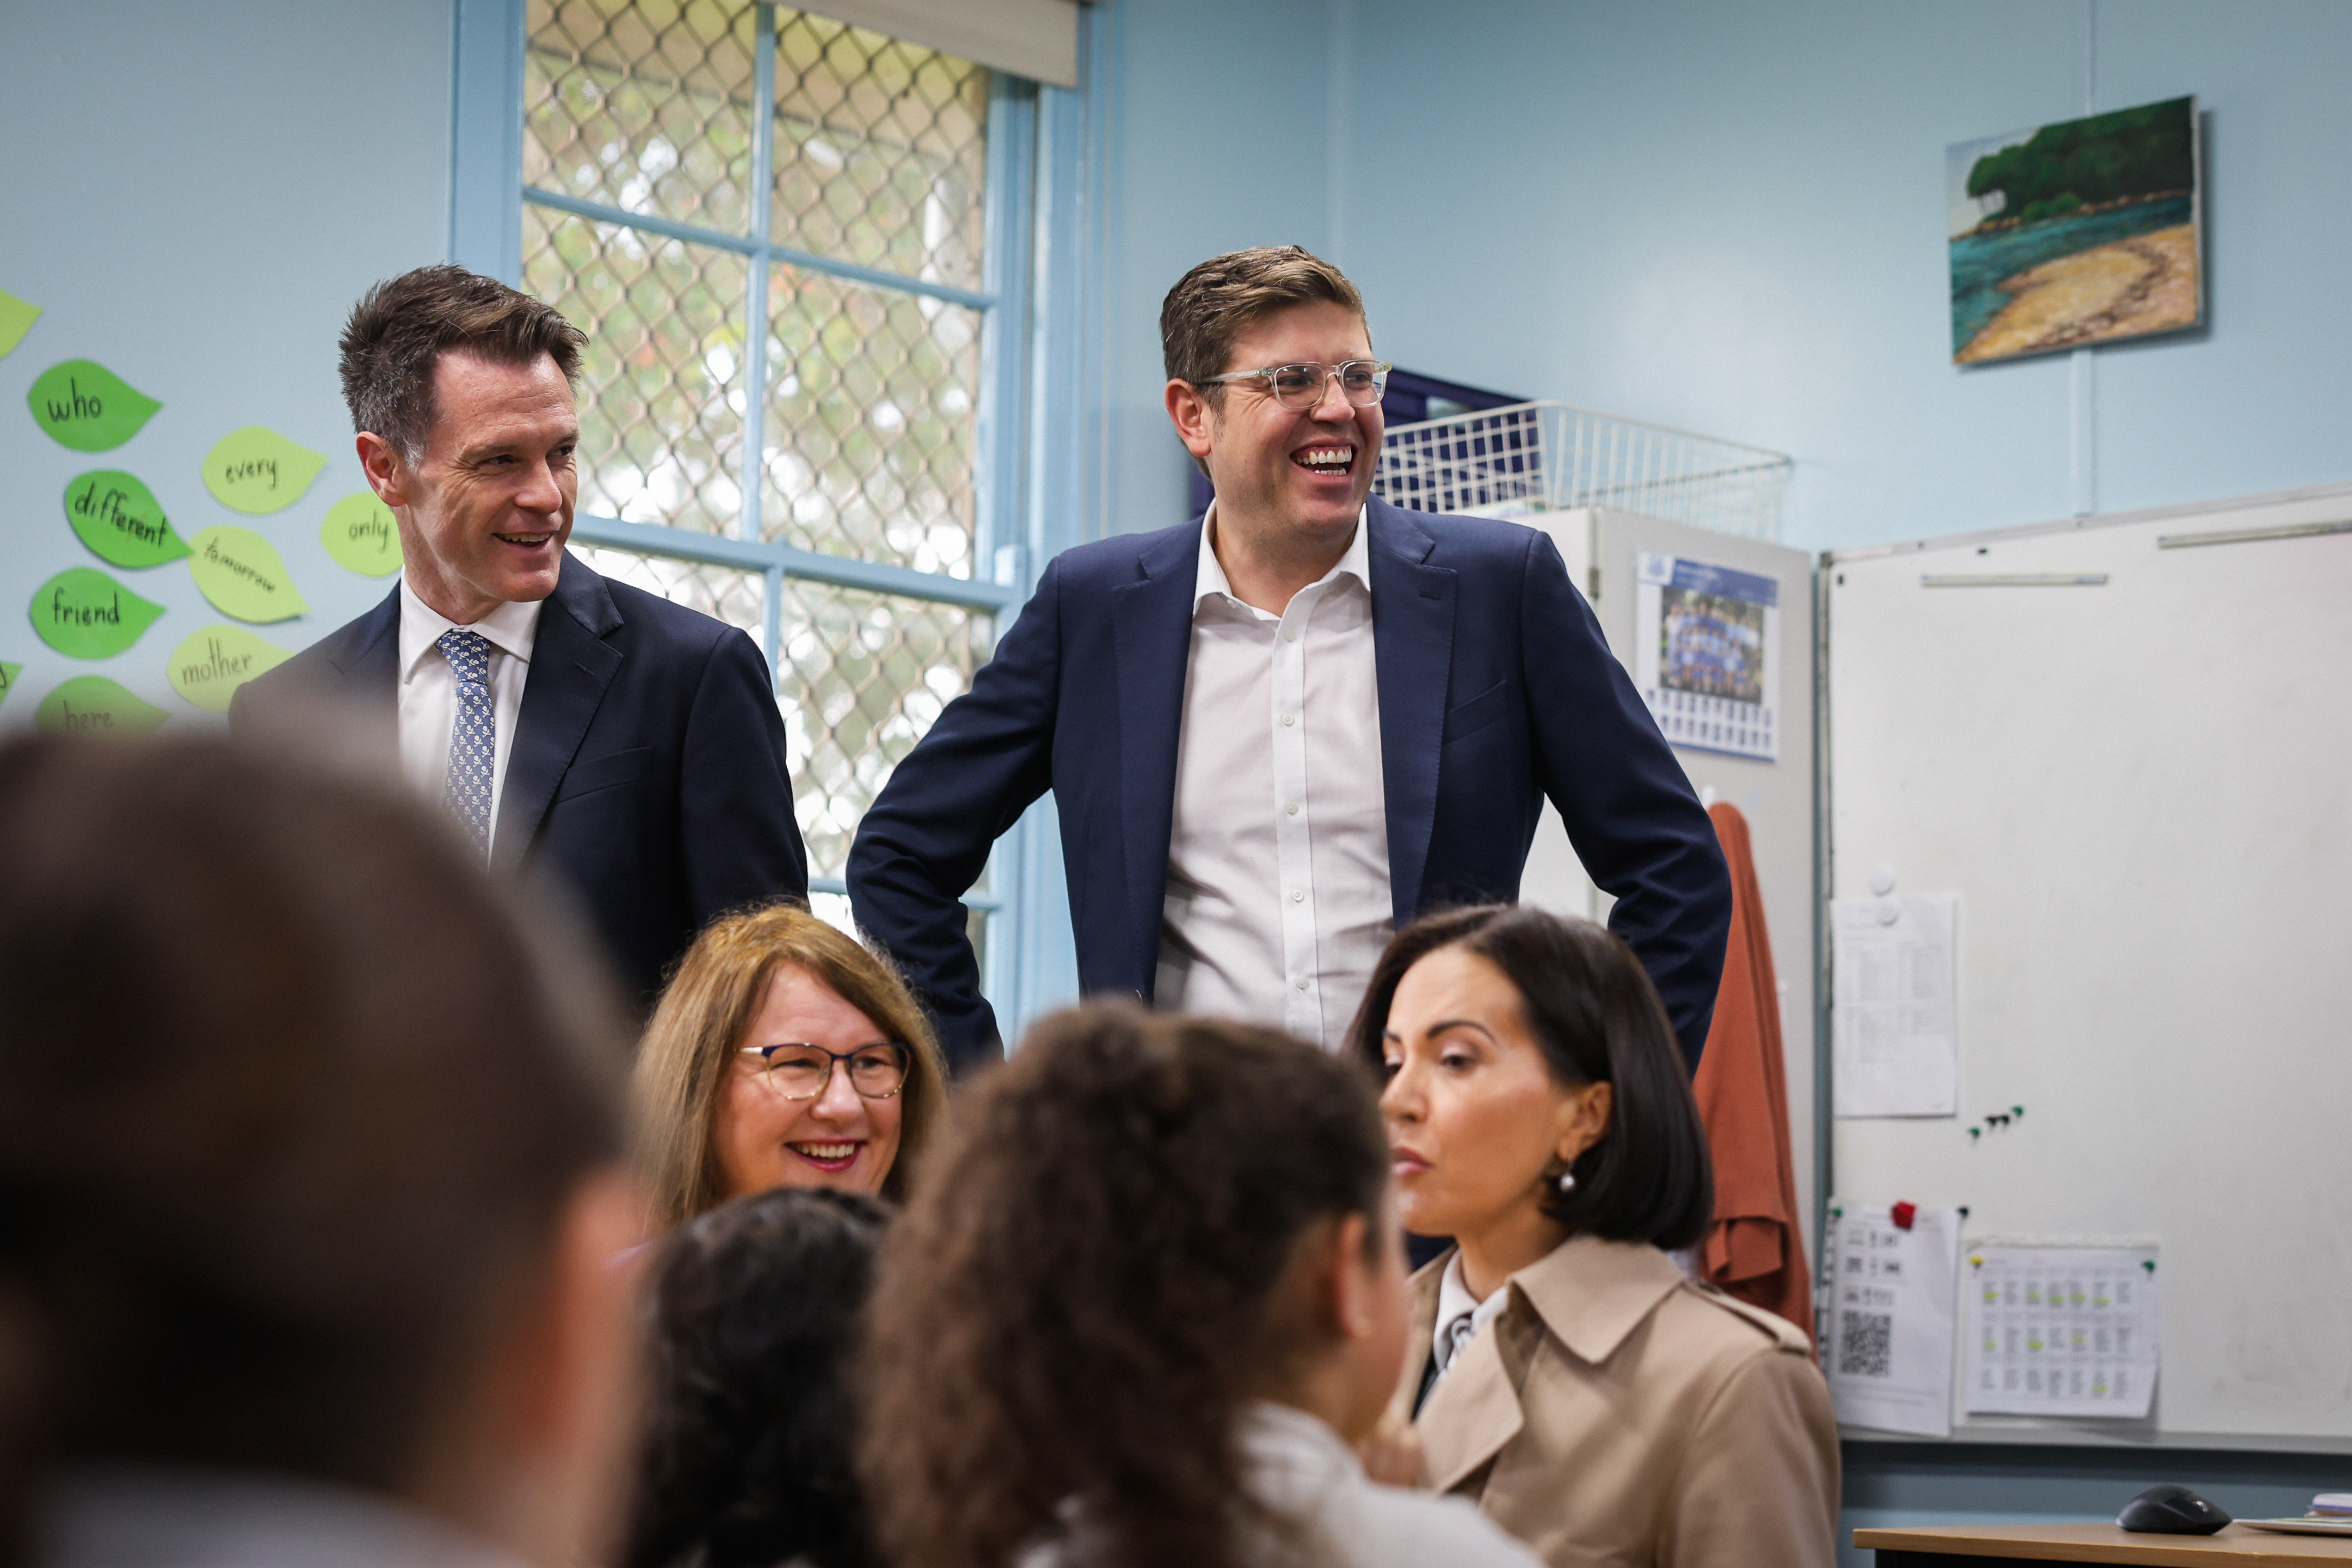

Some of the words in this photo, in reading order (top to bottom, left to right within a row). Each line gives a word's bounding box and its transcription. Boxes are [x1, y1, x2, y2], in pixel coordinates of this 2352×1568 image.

[48, 375, 102, 423] who
[225, 457, 277, 490] every
[74, 480, 167, 547] different
[348, 510, 389, 553] only
[204, 535, 275, 593] tomorrow
[53, 589, 120, 627] friend
[181, 638, 252, 685] mother
[63, 700, 113, 730] here
